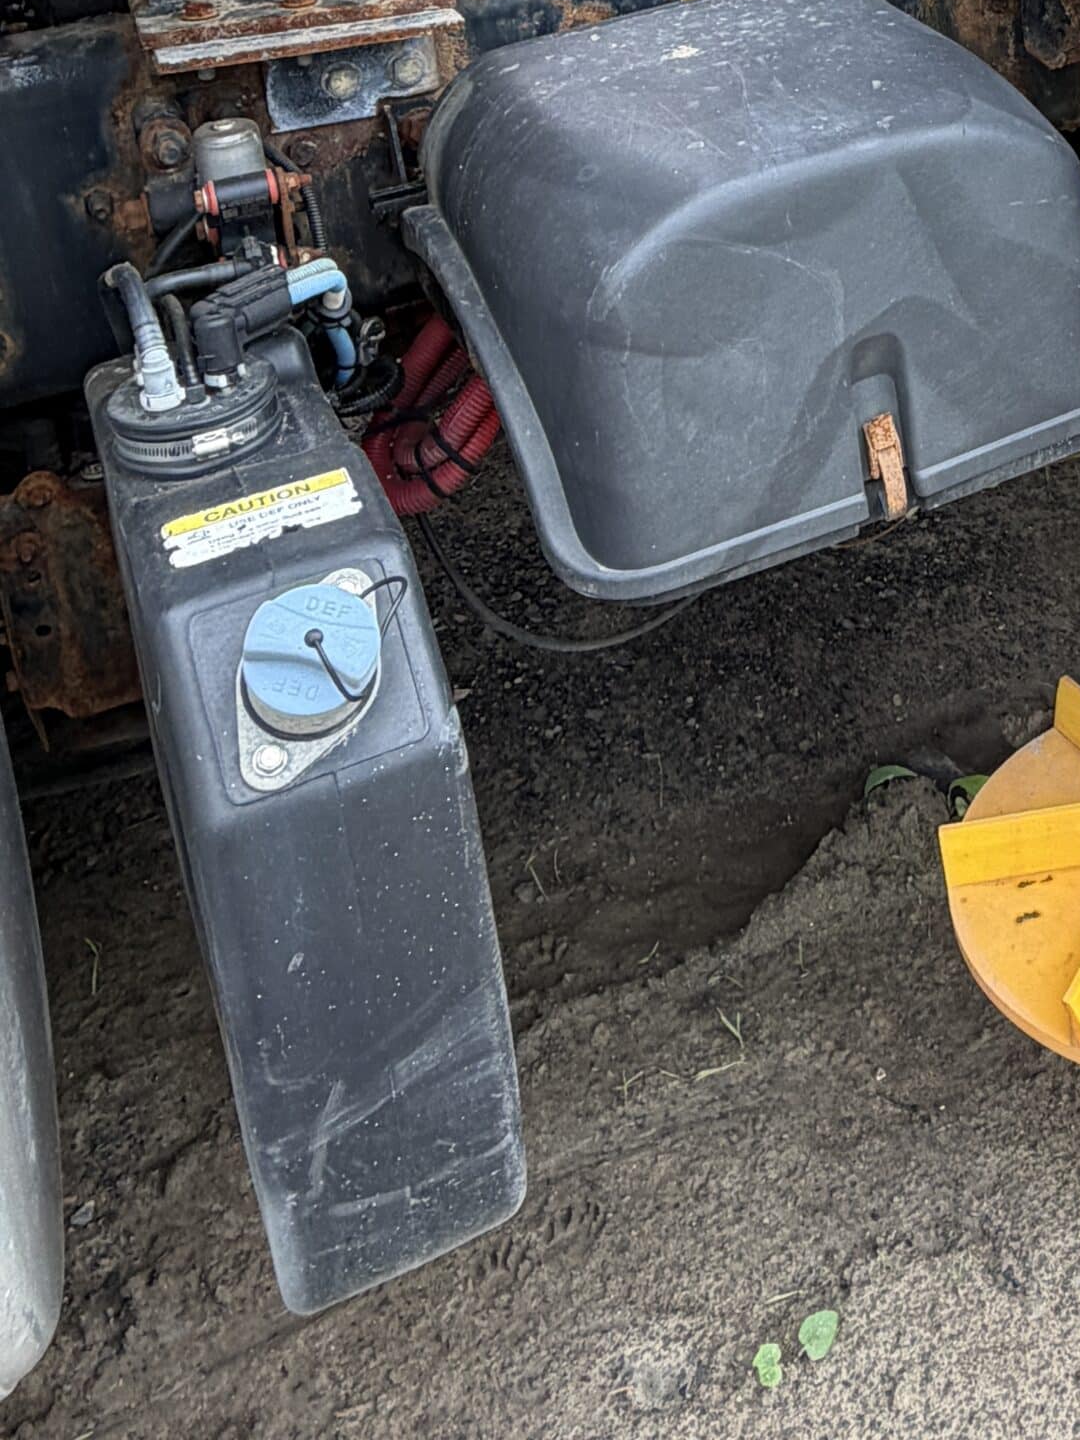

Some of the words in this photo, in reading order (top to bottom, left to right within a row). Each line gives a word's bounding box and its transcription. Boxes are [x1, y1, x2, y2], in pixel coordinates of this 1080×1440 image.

[204, 483, 311, 522] CAUTION
[229, 515, 256, 529] USE
[259, 506, 284, 520] DEF
[288, 495, 321, 510] ONLY
[305, 596, 353, 619] DEF
[271, 676, 320, 701] DEF
